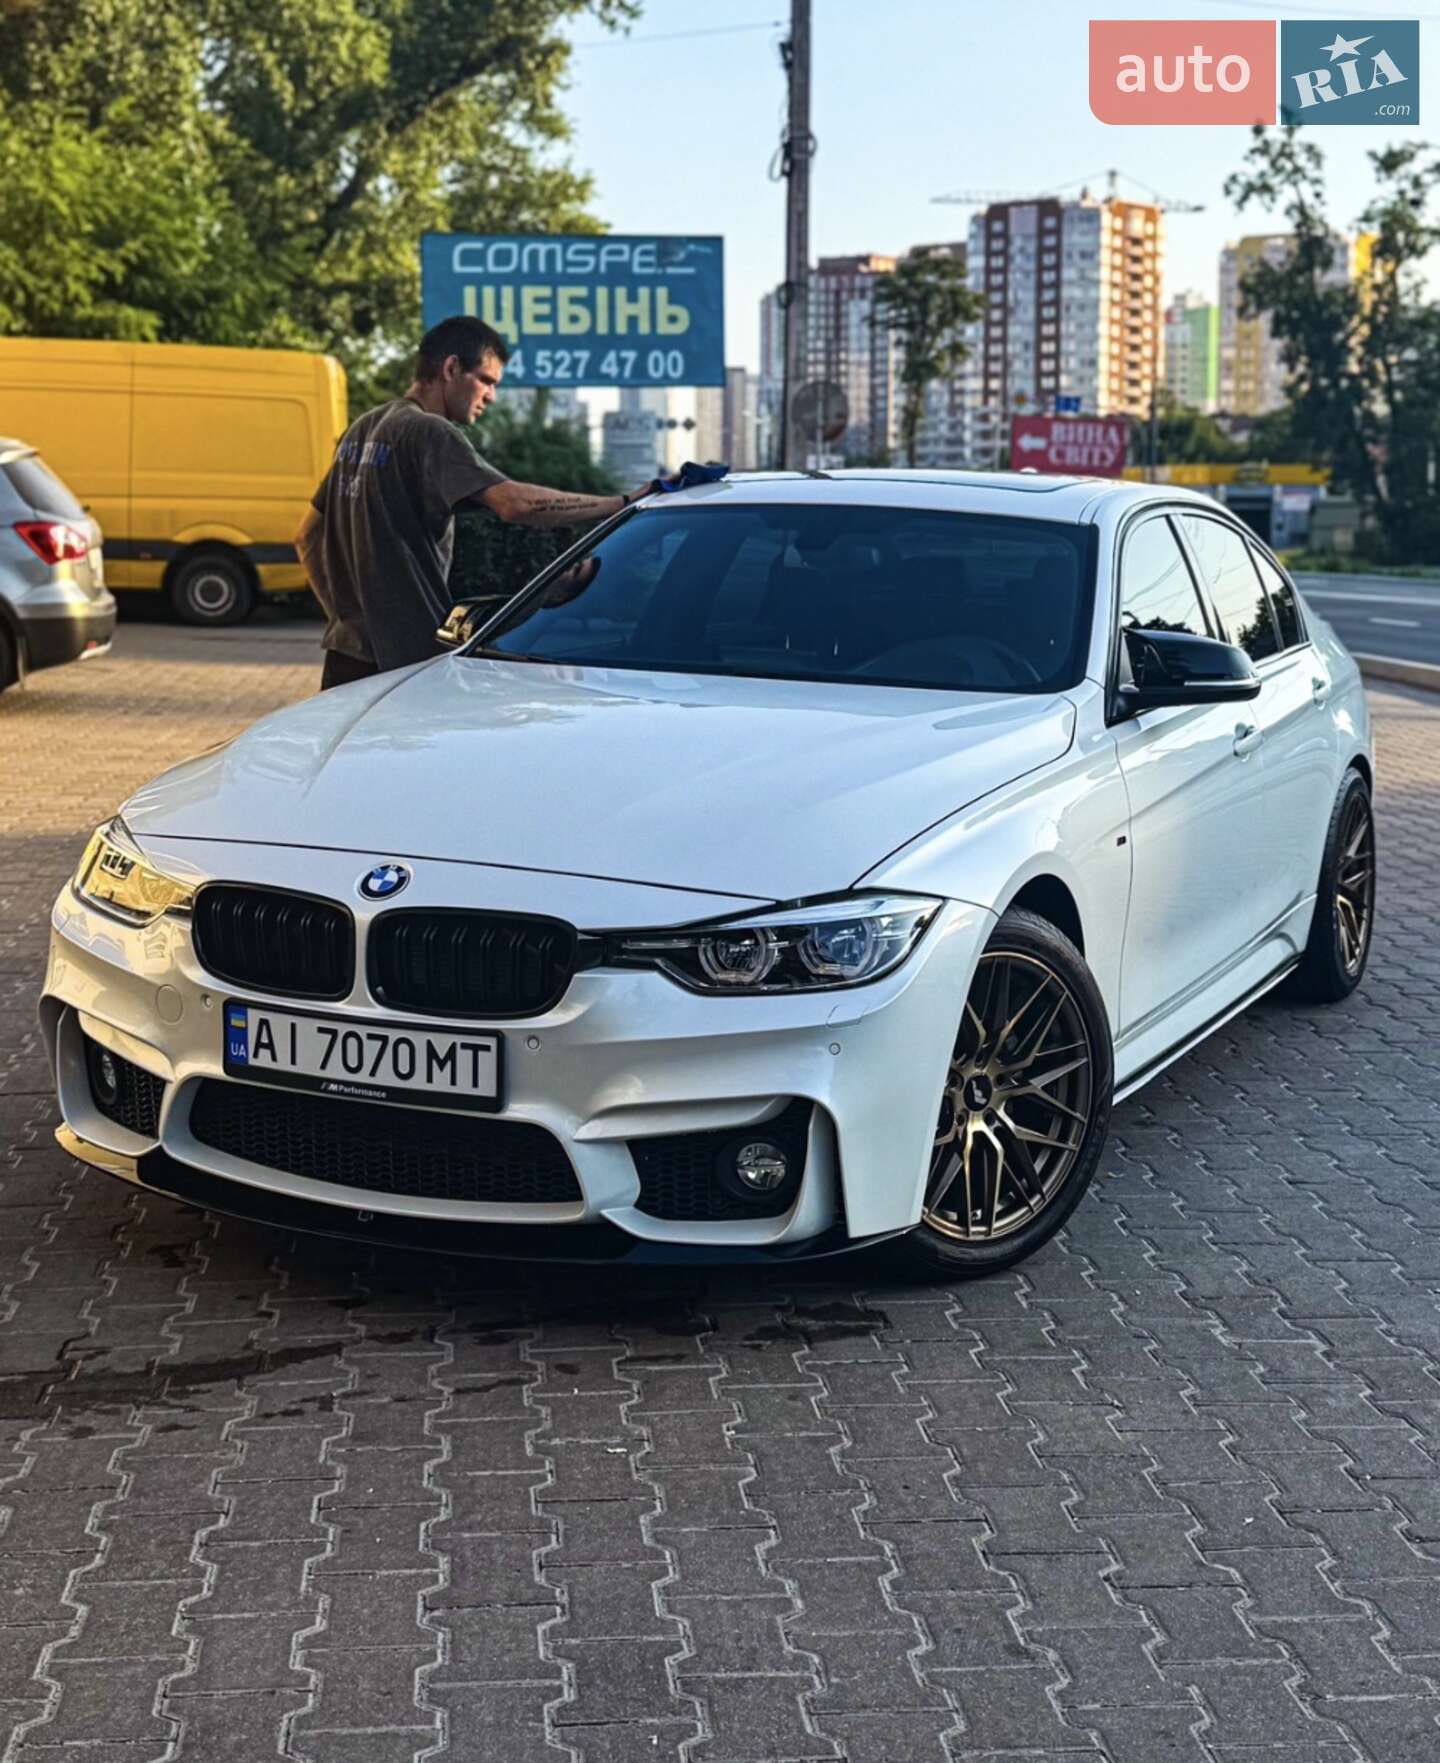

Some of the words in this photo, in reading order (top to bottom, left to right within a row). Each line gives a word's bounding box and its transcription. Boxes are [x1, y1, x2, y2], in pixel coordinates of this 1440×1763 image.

[463, 285, 690, 344] ЩЕБІНЬ
[535, 350, 590, 379] 527
[601, 350, 637, 379] 47
[647, 350, 685, 379] 00
[230, 1043, 246, 1058] UA
[317, 1026, 416, 1081] 7070
